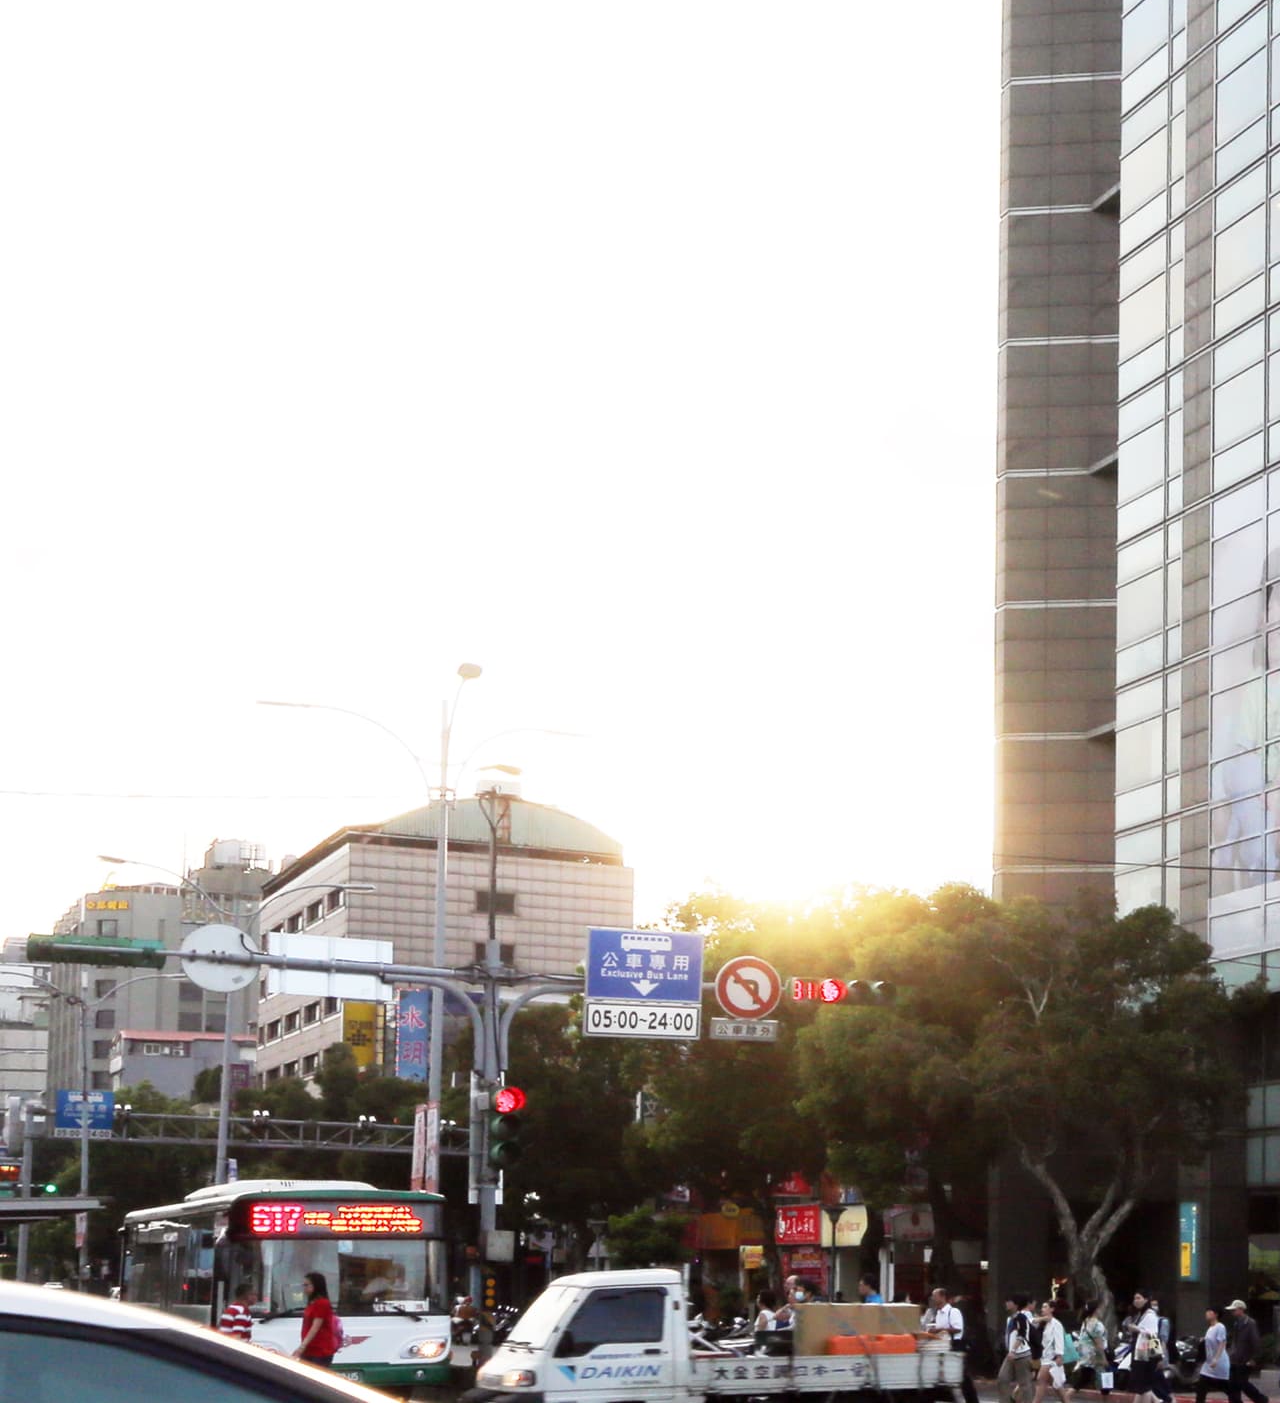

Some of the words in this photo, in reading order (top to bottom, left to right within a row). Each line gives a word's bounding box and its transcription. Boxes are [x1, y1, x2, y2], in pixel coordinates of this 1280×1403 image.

[601, 951, 691, 972] 公車專用
[601, 968, 644, 980] Exclusive
[646, 970, 664, 981] Bus
[667, 972, 689, 982] Lane
[592, 1009, 694, 1032] 05:00~24:00
[580, 1365, 662, 1380] DAIKIN
